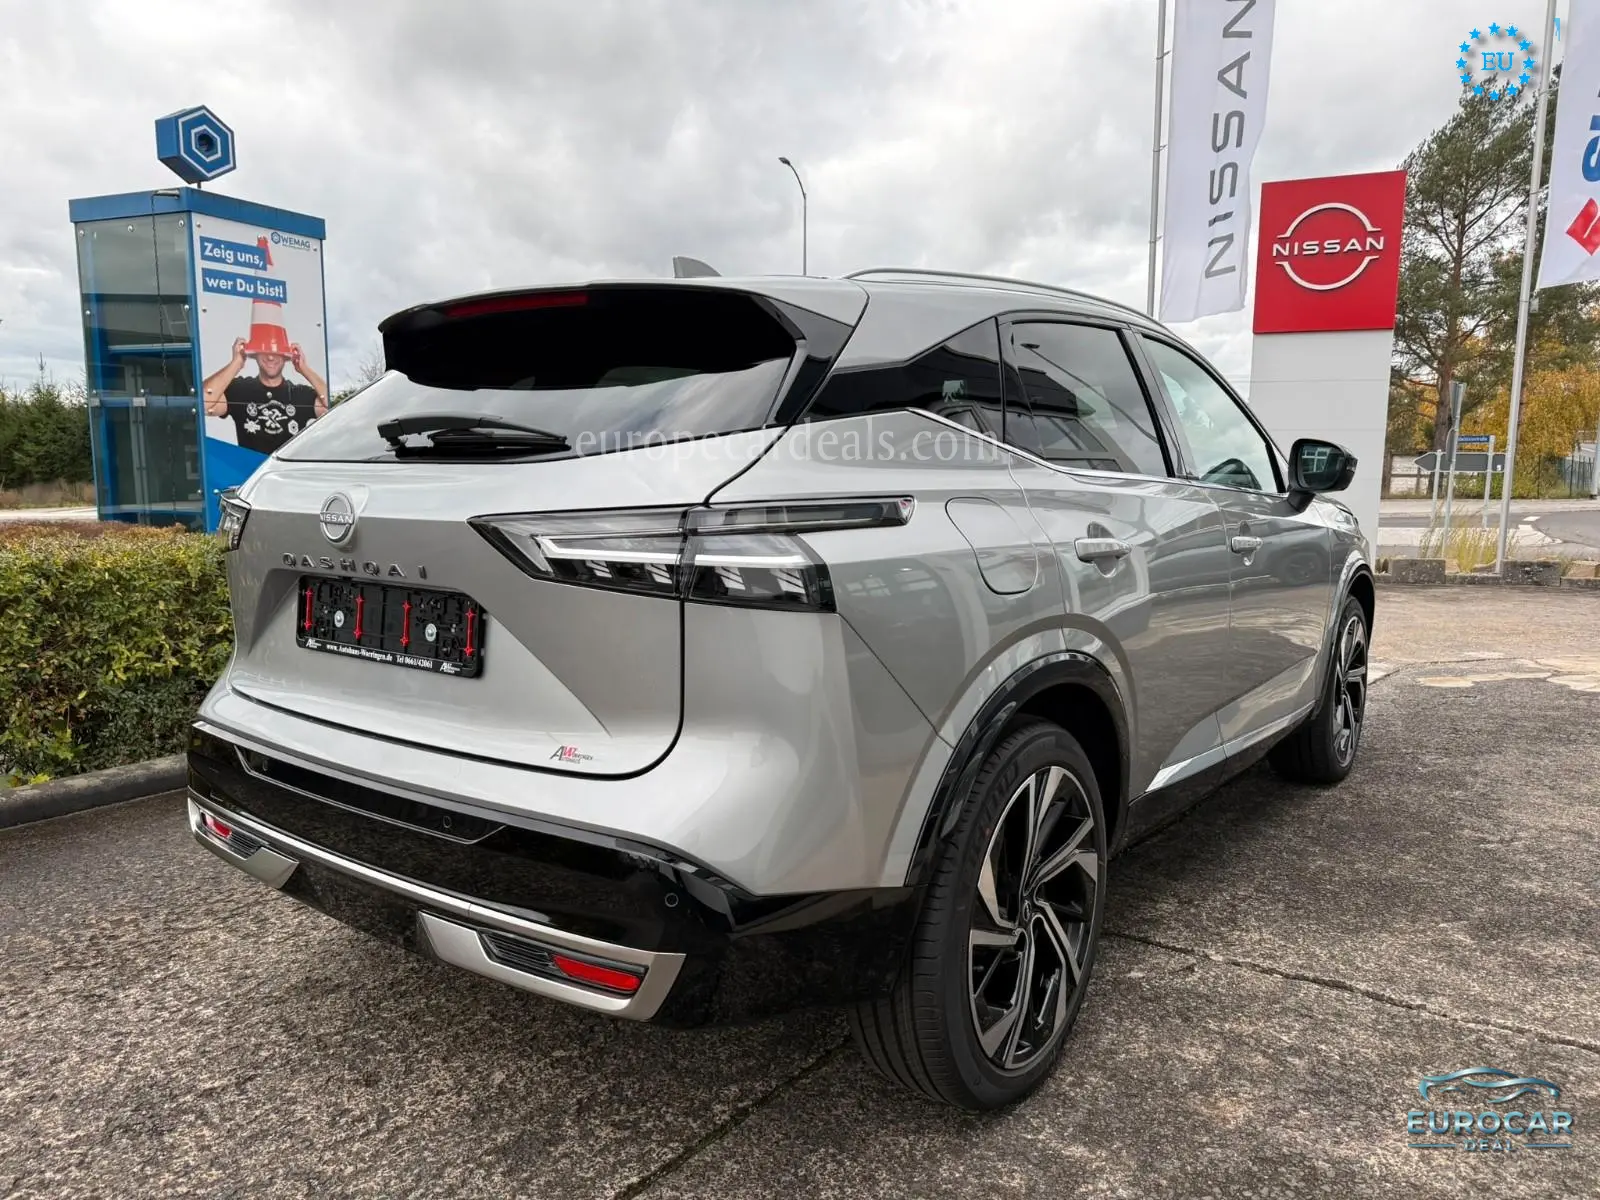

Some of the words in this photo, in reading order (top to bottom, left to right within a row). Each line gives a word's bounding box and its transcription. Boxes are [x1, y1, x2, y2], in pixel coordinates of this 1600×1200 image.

[1204, 0, 1253, 279] NISSAN
[280, 235, 311, 249] WEMAG
[1272, 236, 1385, 257] NISSAN
[203, 242, 234, 264] Zeig
[237, 252, 263, 268] uns,
[205, 277, 233, 290] wer
[236, 278, 254, 293] Du
[257, 280, 284, 298] bist!
[320, 512, 353, 524] NISSAN
[282, 552, 428, 580] QASHQAI
